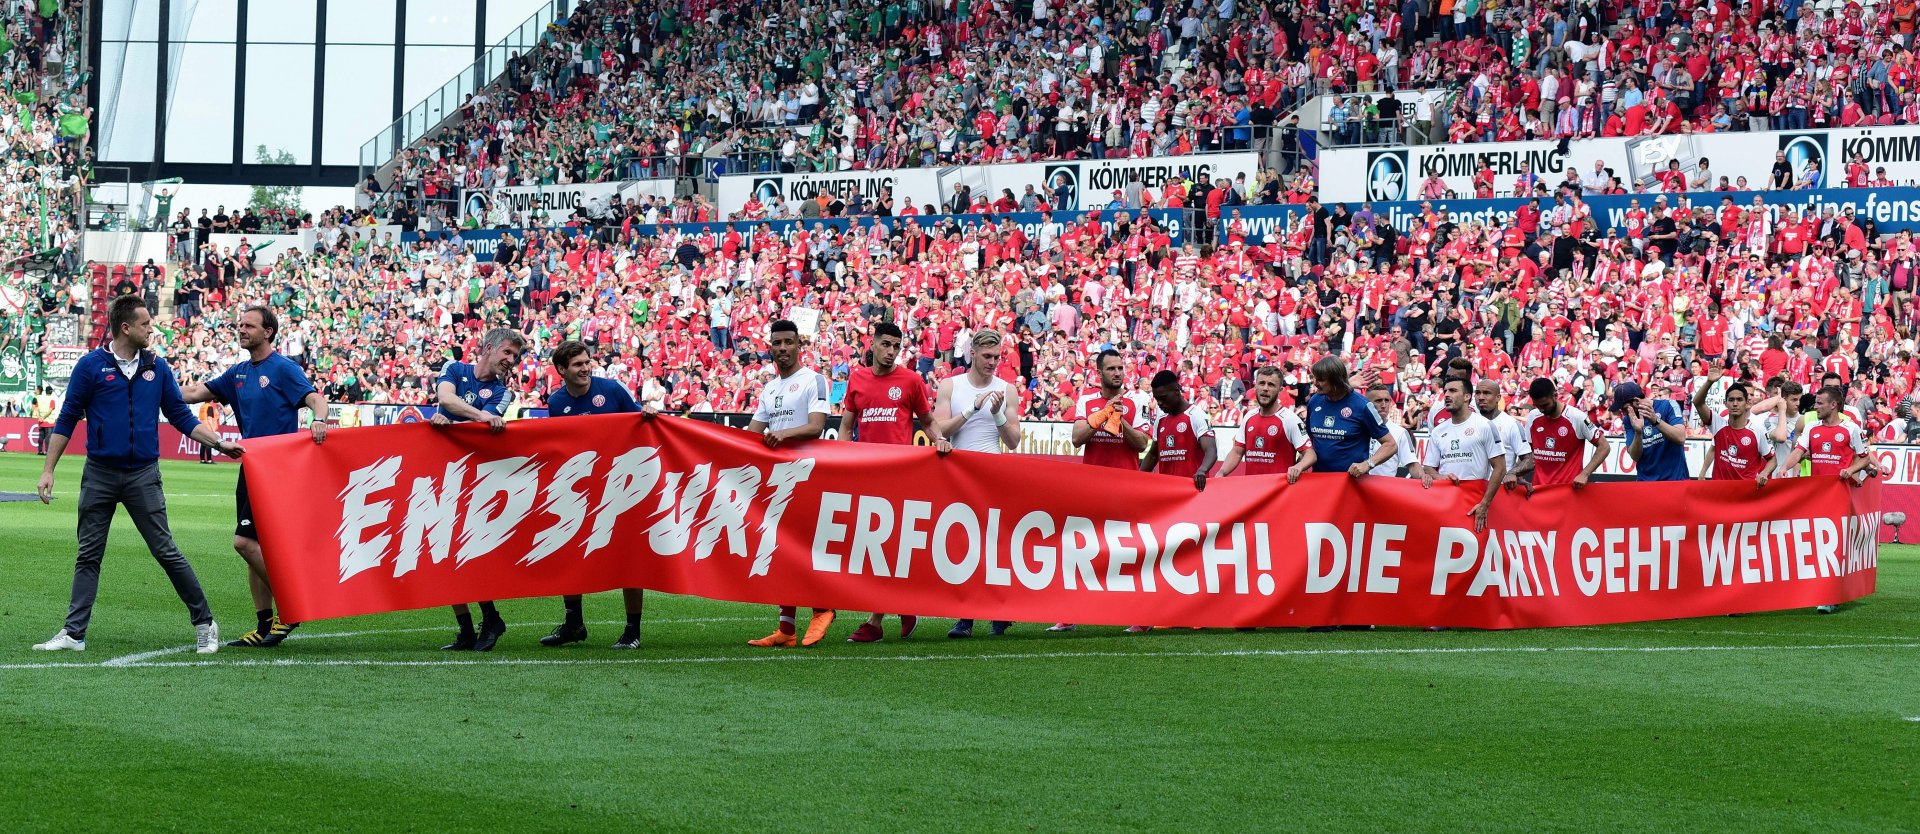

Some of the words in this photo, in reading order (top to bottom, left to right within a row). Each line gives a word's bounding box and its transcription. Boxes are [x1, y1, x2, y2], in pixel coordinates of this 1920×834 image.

[335, 446, 815, 583] ENDSPURT
[812, 492, 1275, 596] ERFOLGREICH!
[1305, 523, 1405, 594] DIE
[1431, 526, 1559, 597] PARTY
[1571, 525, 1686, 597] GEHT
[1699, 515, 1848, 587] WEITER!
[1848, 511, 1881, 575] DANK
